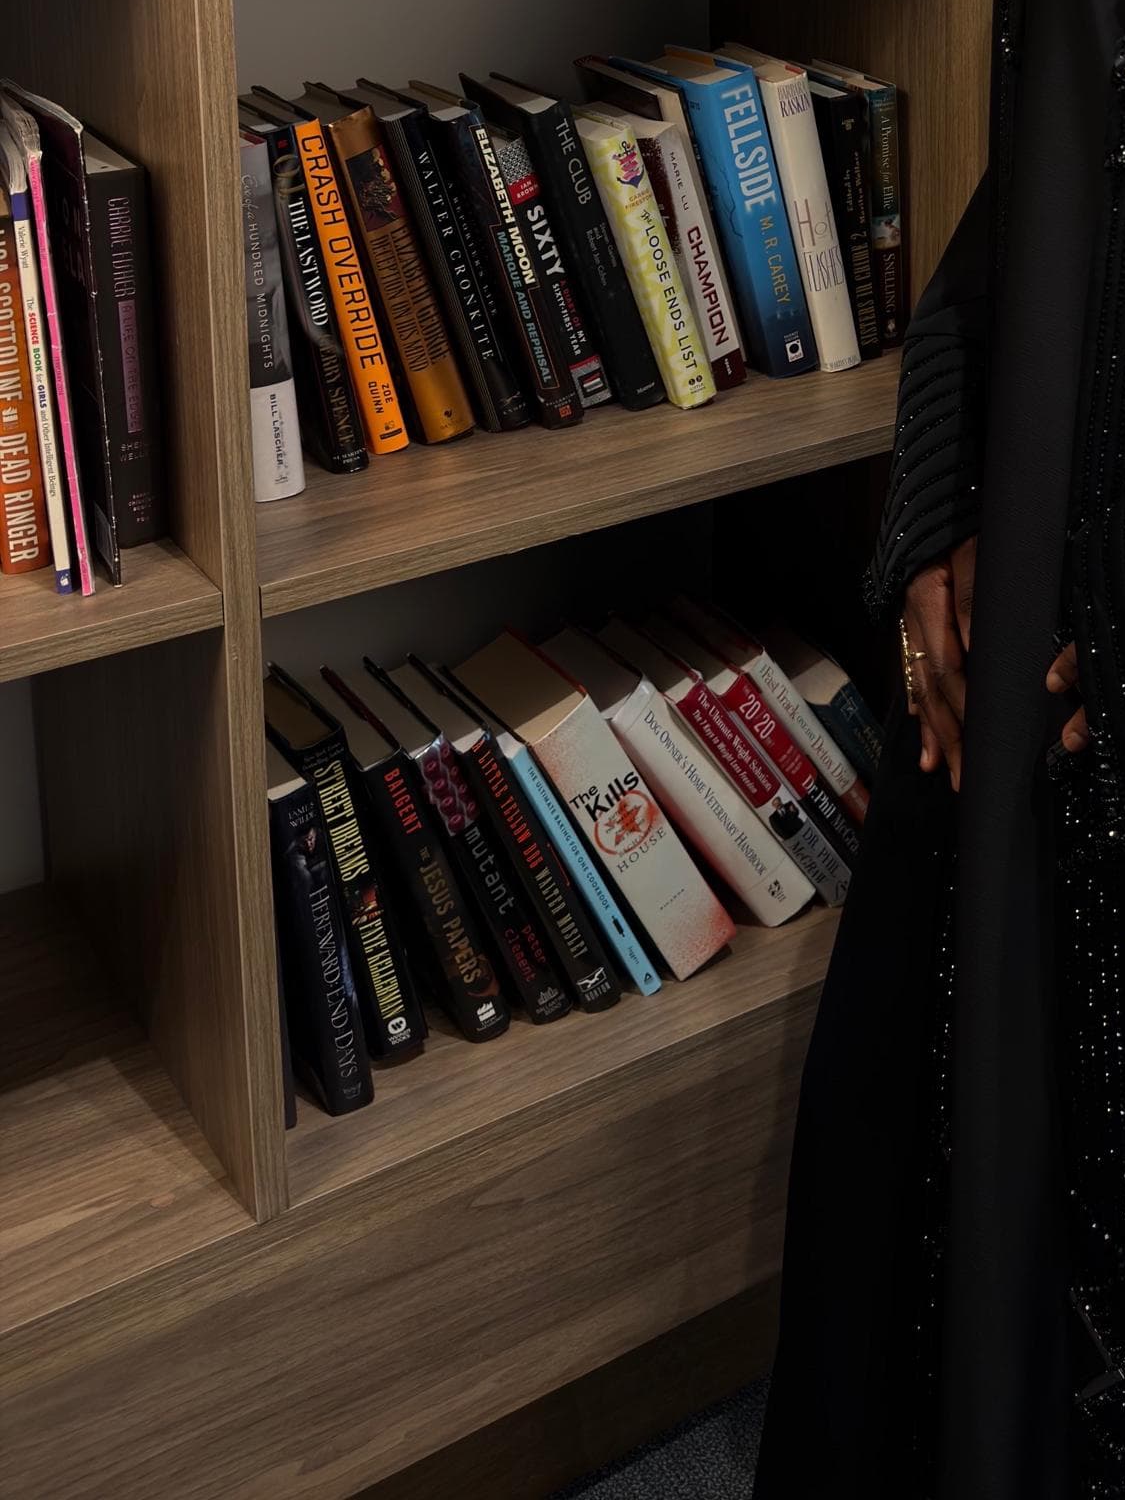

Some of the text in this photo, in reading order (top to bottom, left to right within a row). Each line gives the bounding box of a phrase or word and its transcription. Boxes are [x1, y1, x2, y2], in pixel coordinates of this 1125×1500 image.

[475, 128, 536, 285] ELIZABETH MOON
[569, 158, 592, 206] CLUB
[669, 151, 684, 190] MARIE
[719, 84, 792, 305] FELLSIDE CAREY
[107, 197, 132, 248] CARRIE
[301, 135, 384, 369] CRASH OVERRIDE
[418, 151, 494, 360] WALTER CRONKITE
[527, 205, 566, 277] SIXTY
[248, 223, 273, 369] HUNDRED MIDNIGHTS
[294, 234, 329, 327] LAST WORD
[369, 234, 407, 301] DECEPTION
[389, 225, 449, 365] ELIZABETH GEORGE
[645, 226, 697, 370] LOOSE ENDS LIST
[687, 226, 729, 347] CHAMPION
[882, 253, 897, 314] SNELLING
[496, 231, 551, 384] MARQUE REPRISAL
[552, 283, 581, 356] SIXTY-FIRST YEAR
[28, 311, 47, 408] SCIENCE BOOK GIRLS
[381, 383, 393, 404] ZOE
[328, 387, 354, 445] SPENCE
[368, 381, 384, 414] QUINN
[272, 419, 283, 466] LASCHER
[0, 432, 39, 564] DEAD RINGER
[708, 705, 773, 792] Ultimate Solution
[313, 759, 355, 823] STREET
[384, 767, 424, 834] BAIGENT
[570, 785, 599, 809] The
[584, 771, 640, 823] Kills
[329, 822, 371, 883] DREAMS
[477, 750, 588, 959] LITTLE YELLOW WALTER MOSLEY
[535, 777, 612, 911] ULTIMATE COOKBOOK
[616, 827, 668, 874] HOUSE
[702, 787, 766, 877] VETERINARY HANDBOOK
[464, 822, 515, 916] mutant
[419, 860, 484, 985] JESUS PAPERS
[367, 949, 405, 1020] KELLERMAN
[335, 1030, 358, 1079] DAYS
